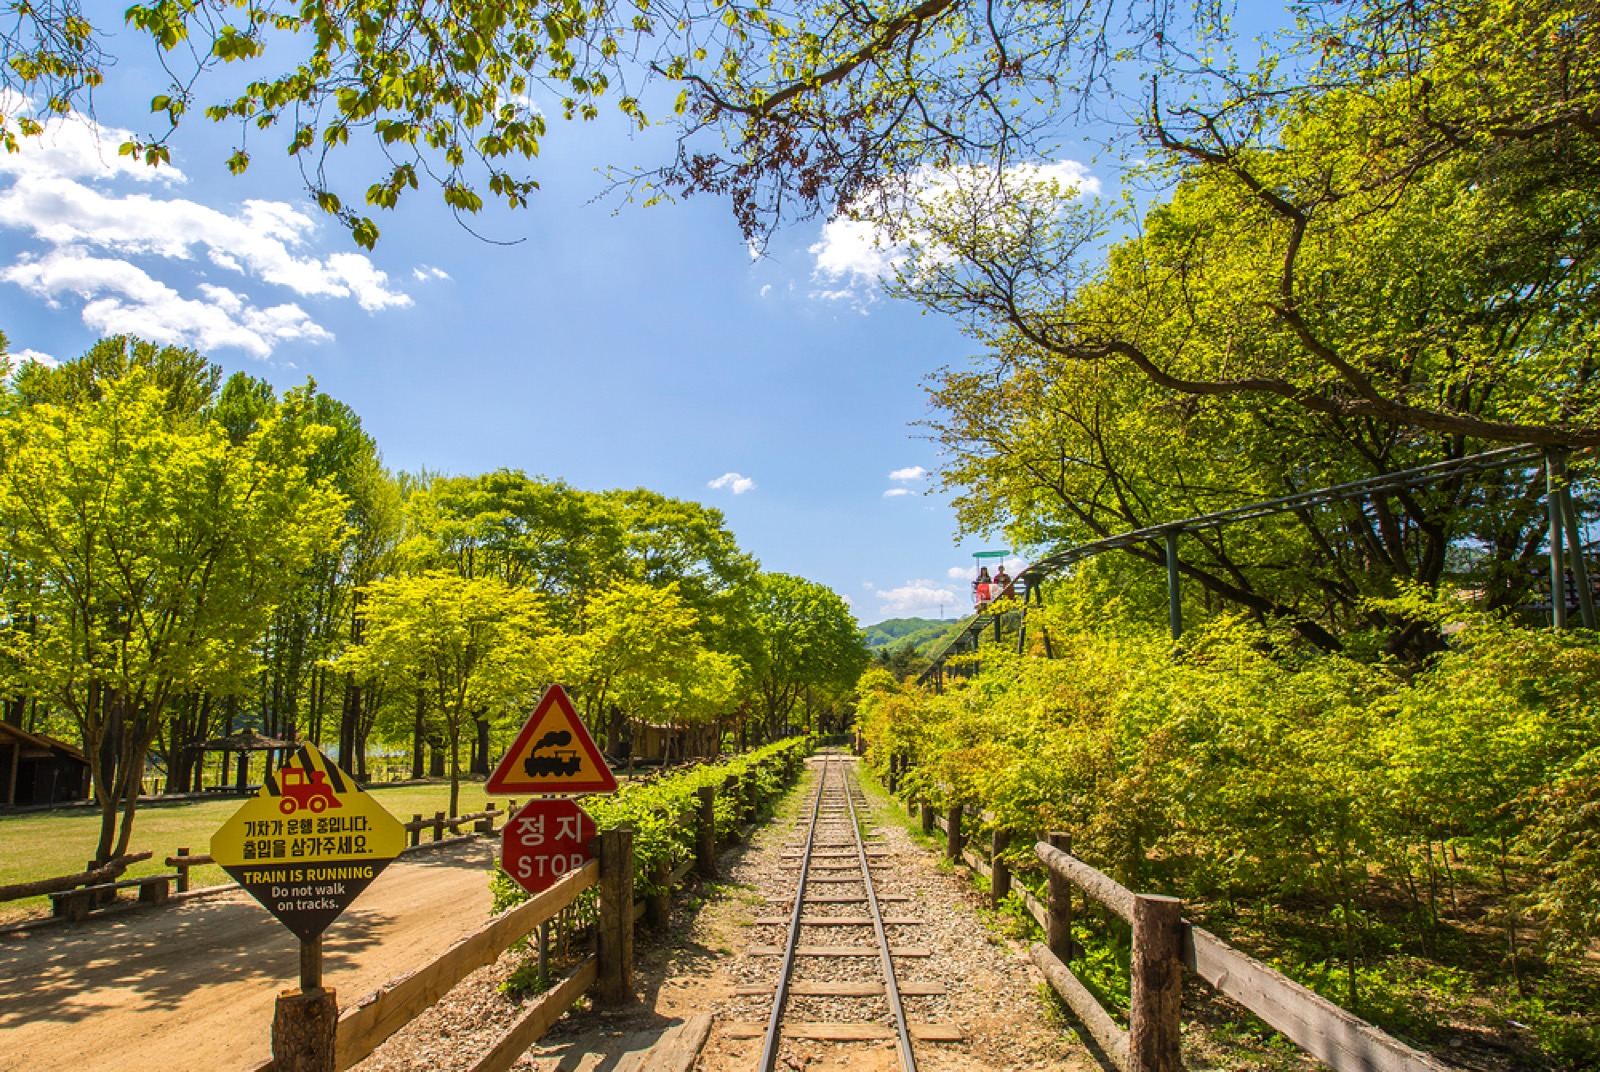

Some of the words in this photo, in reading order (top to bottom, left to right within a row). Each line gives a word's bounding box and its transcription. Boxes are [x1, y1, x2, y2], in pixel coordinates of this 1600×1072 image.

[244, 820, 283, 838] 기차가
[287, 818, 313, 836] 운행
[316, 815, 372, 834] 중입니다.
[243, 839, 286, 859] 출입을
[290, 834, 373, 857] 삼가주세요.
[243, 870, 286, 884] TRAIN
[290, 869, 303, 882] IS
[306, 866, 374, 881] RUNNING
[517, 854, 584, 878] STOP
[271, 885, 289, 898] Do
[291, 885, 313, 897] not
[314, 882, 346, 896] walk
[277, 901, 294, 911] on
[297, 897, 339, 910] tracks.
